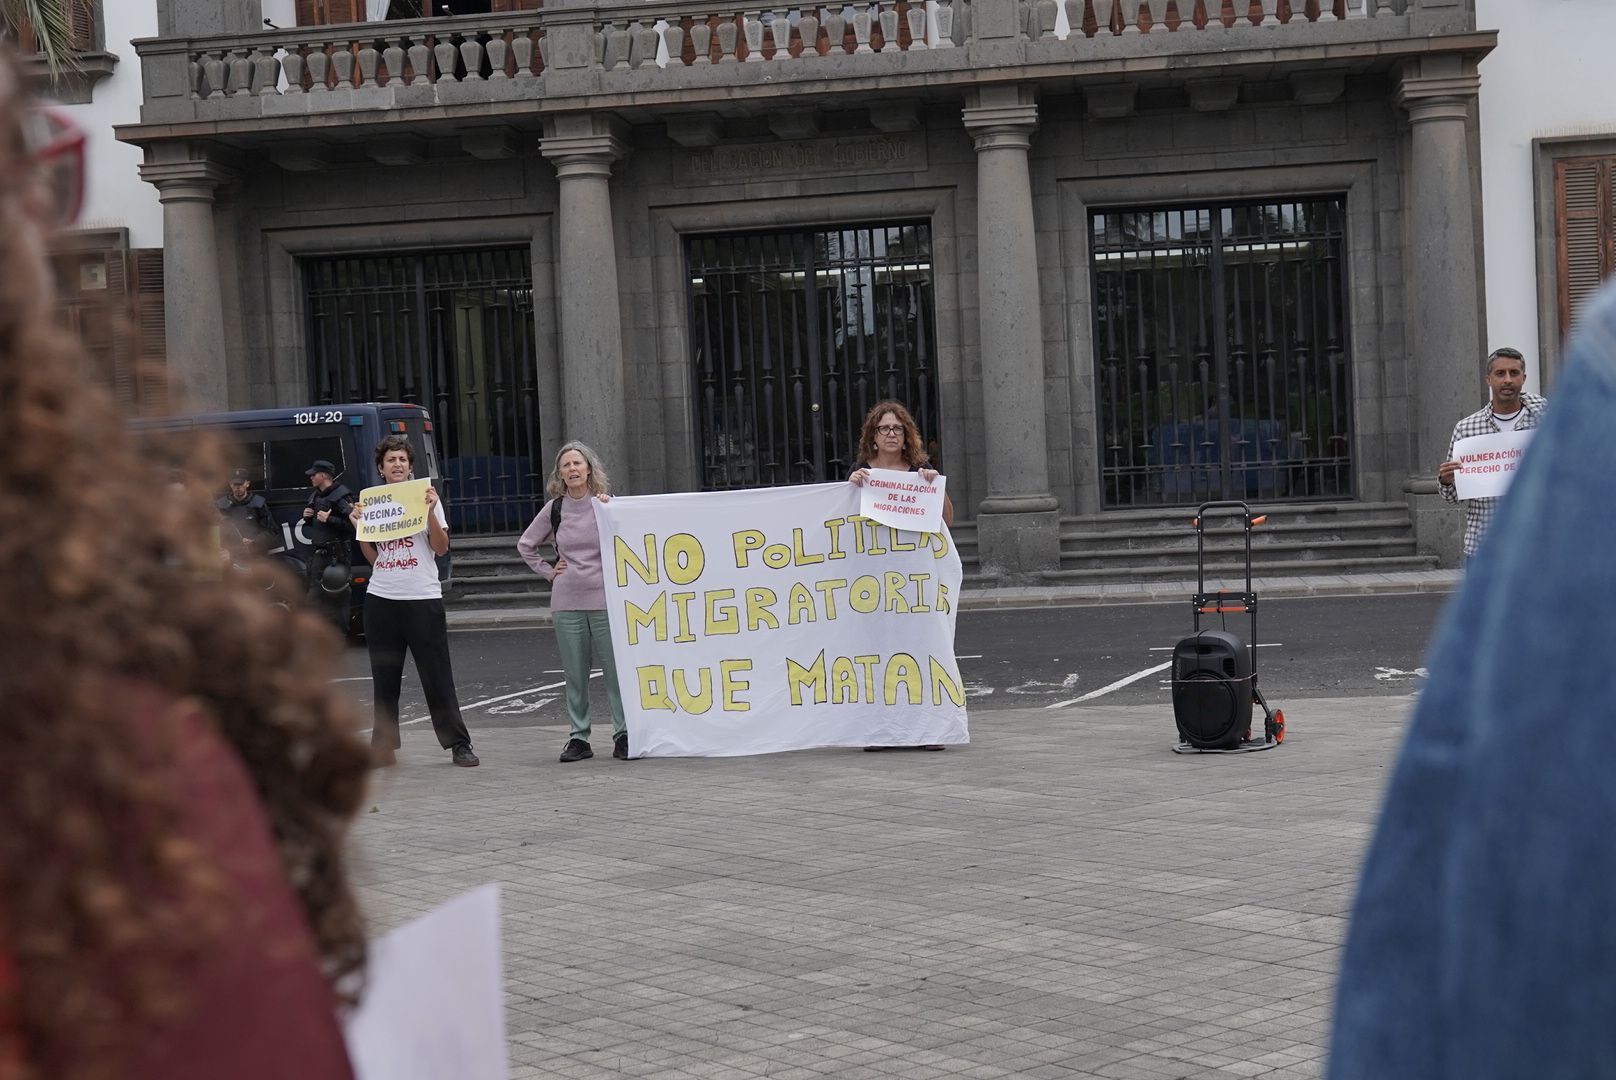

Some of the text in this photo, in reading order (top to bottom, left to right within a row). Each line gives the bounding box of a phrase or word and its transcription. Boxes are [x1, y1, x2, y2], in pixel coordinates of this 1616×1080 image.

[294, 411, 343, 425] 10U-20
[1460, 447, 1522, 463] VULNERACIÓN
[1459, 462, 1516, 473] DERECHO DE
[362, 494, 392, 506] SOMOS
[888, 493, 917, 503] DE LAS
[873, 502, 925, 515] MIGRACIONES
[362, 516, 423, 534] NO ENEMIGAS
[613, 532, 705, 587] NO
[635, 648, 967, 716] QUE MATAN
